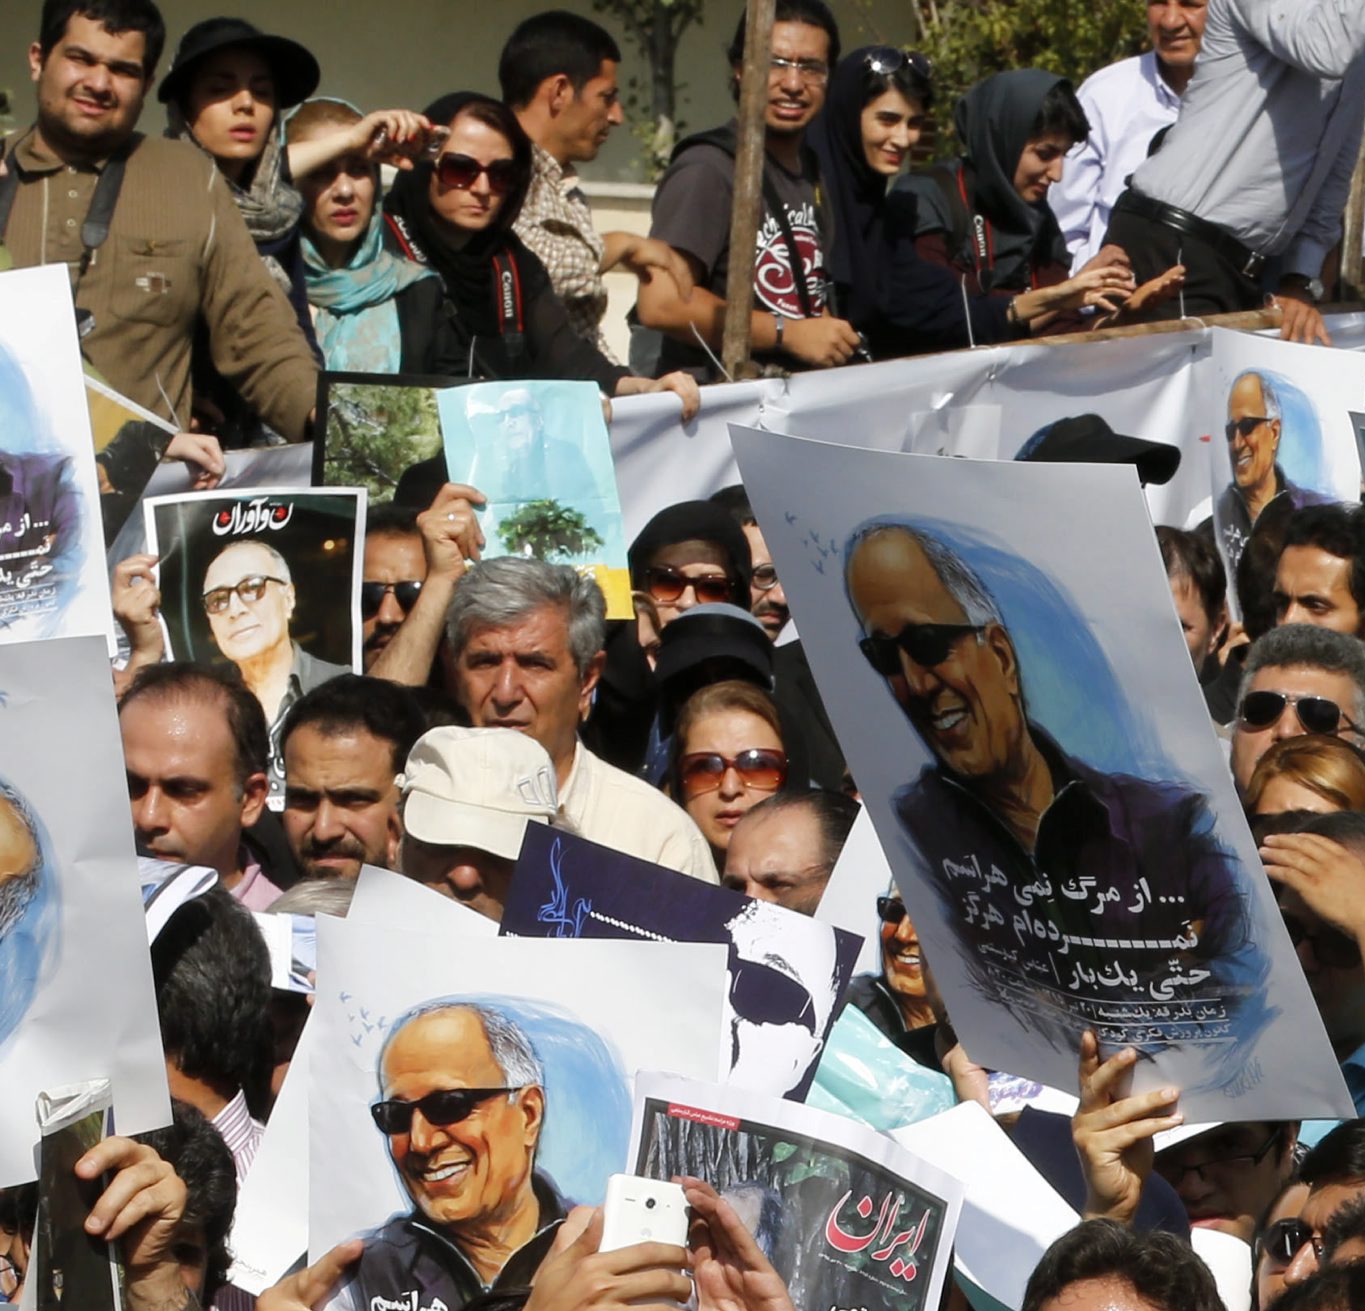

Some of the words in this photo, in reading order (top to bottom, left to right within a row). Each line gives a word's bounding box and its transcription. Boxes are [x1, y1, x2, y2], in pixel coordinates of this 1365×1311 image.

[502, 271, 514, 318] Canon
[964, 892, 1005, 930] هرگز
[1061, 876, 1120, 914] مرگ
[1127, 877, 1152, 913] از
[1196, 1006, 1226, 1020] زمان
[825, 1189, 931, 1281] ایران
